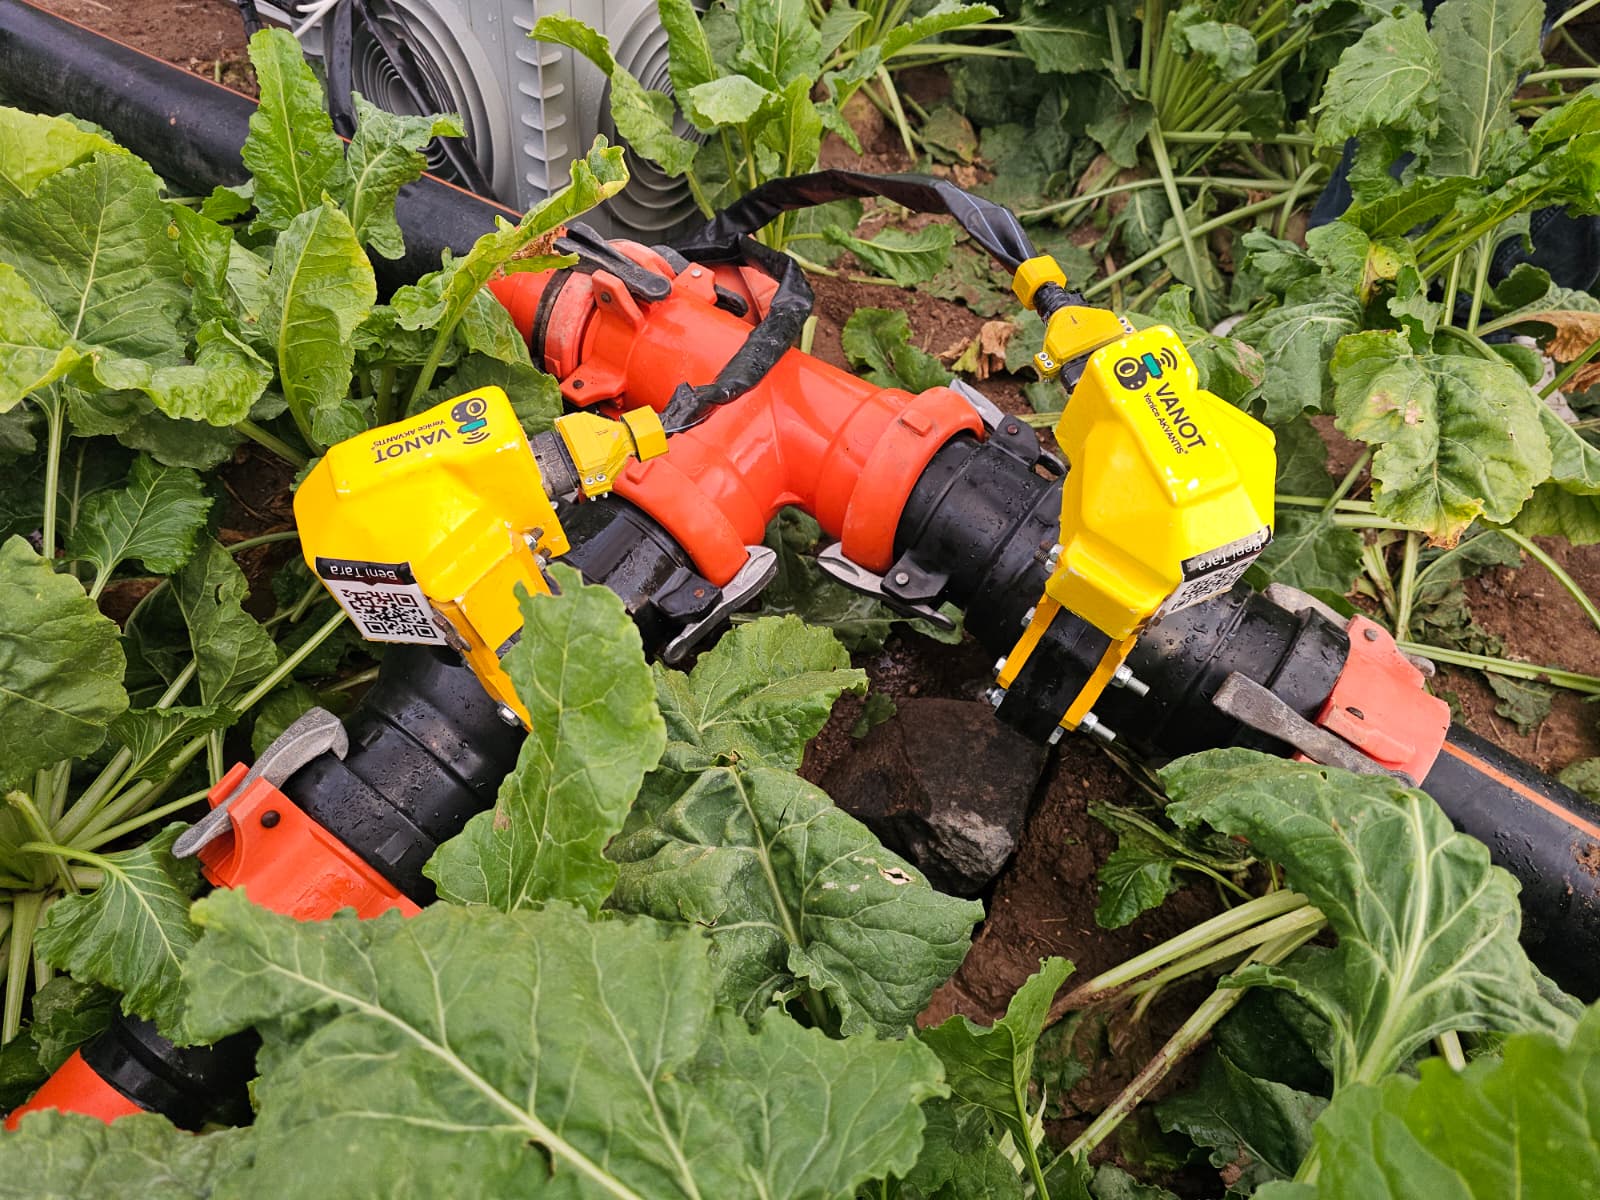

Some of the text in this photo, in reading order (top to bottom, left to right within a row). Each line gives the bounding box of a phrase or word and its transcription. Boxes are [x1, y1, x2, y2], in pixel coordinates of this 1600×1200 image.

[1144, 392, 1160, 417] Yenice
[1156, 382, 1207, 448] VANOT
[374, 428, 452, 464] VANOT
[1198, 540, 1262, 571] Beni Tara
[330, 565, 398, 580] Beni Tara
